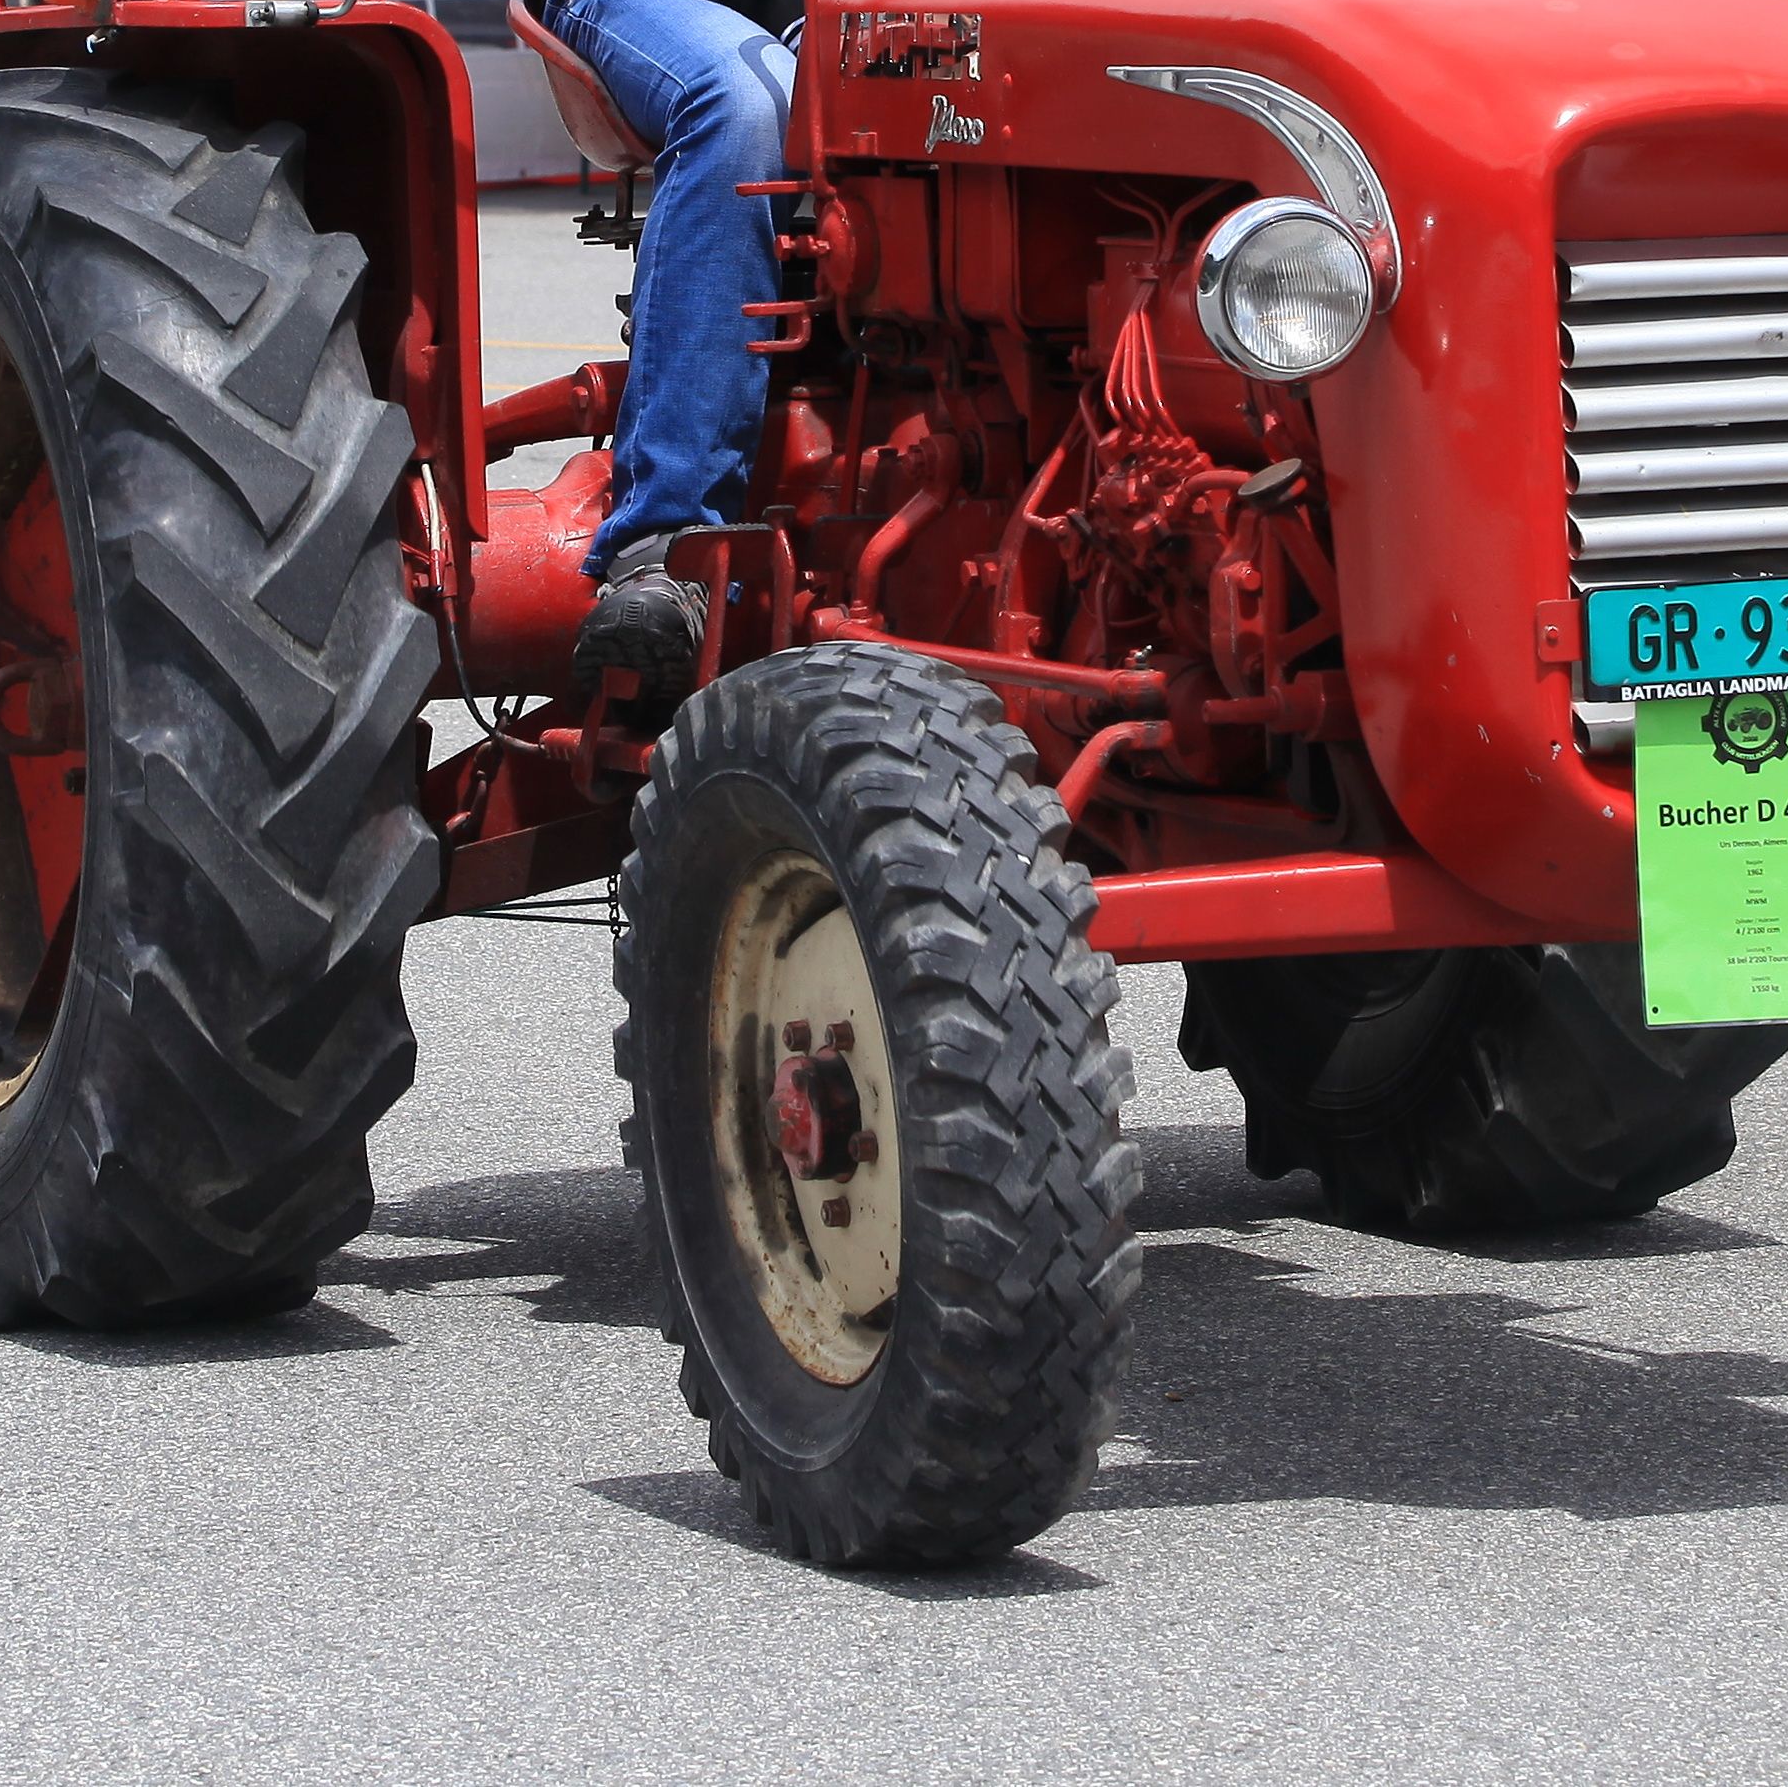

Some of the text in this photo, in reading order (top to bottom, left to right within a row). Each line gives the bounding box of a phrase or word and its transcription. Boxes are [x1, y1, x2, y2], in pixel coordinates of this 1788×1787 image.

[1628, 600, 1700, 672] GR
[1621, 680, 1715, 701] BATTAGLIA
[1658, 800, 1749, 828] Bucher
[1755, 799, 1777, 823] D
[1719, 841, 1732, 849] Urs
